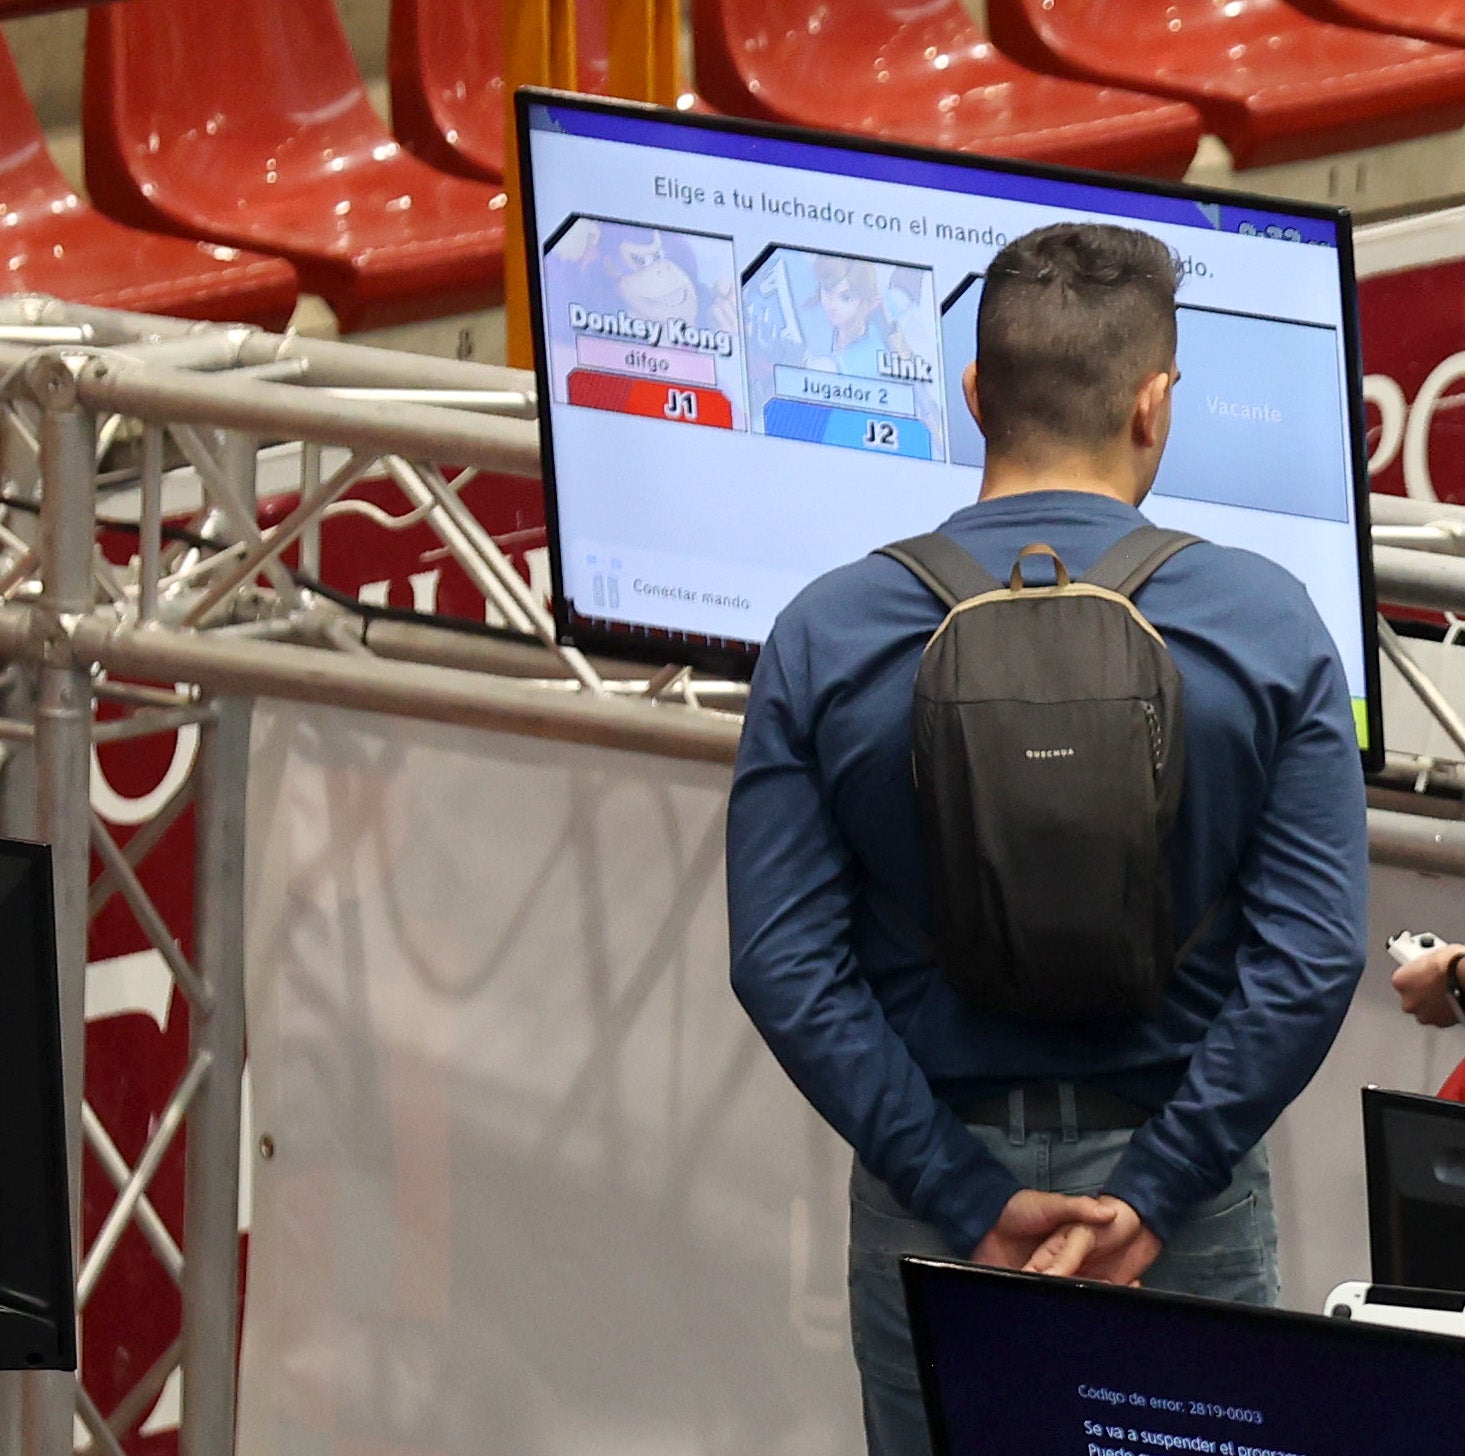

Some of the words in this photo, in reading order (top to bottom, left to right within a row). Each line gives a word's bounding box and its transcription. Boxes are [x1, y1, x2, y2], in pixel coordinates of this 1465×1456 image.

[654, 176, 704, 204] Elige
[713, 189, 725, 206] a
[733, 190, 754, 211] tu
[762, 193, 853, 226] luchador
[863, 211, 901, 233] con
[909, 215, 926, 235] el
[936, 223, 1007, 247] mando
[569, 303, 662, 344] Donkey
[668, 317, 732, 357] Kong
[876, 349, 933, 383] Link
[665, 390, 697, 419] J1
[802, 377, 871, 401] Jugador
[879, 391, 889, 404] 2
[1206, 395, 1282, 422] Vacante
[864, 420, 896, 446] J2
[633, 578, 697, 602] Conectar
[702, 591, 750, 610] mando
[1128, 1393, 1146, 1406] de
[1150, 1397, 1184, 1412] error:
[1084, 1420, 1102, 1436] Se
[1106, 1427, 1124, 1439] va
[1128, 1429, 1138, 1441] a
[1140, 1432, 1215, 1452] suspender
[1220, 1442, 1234, 1456] el
